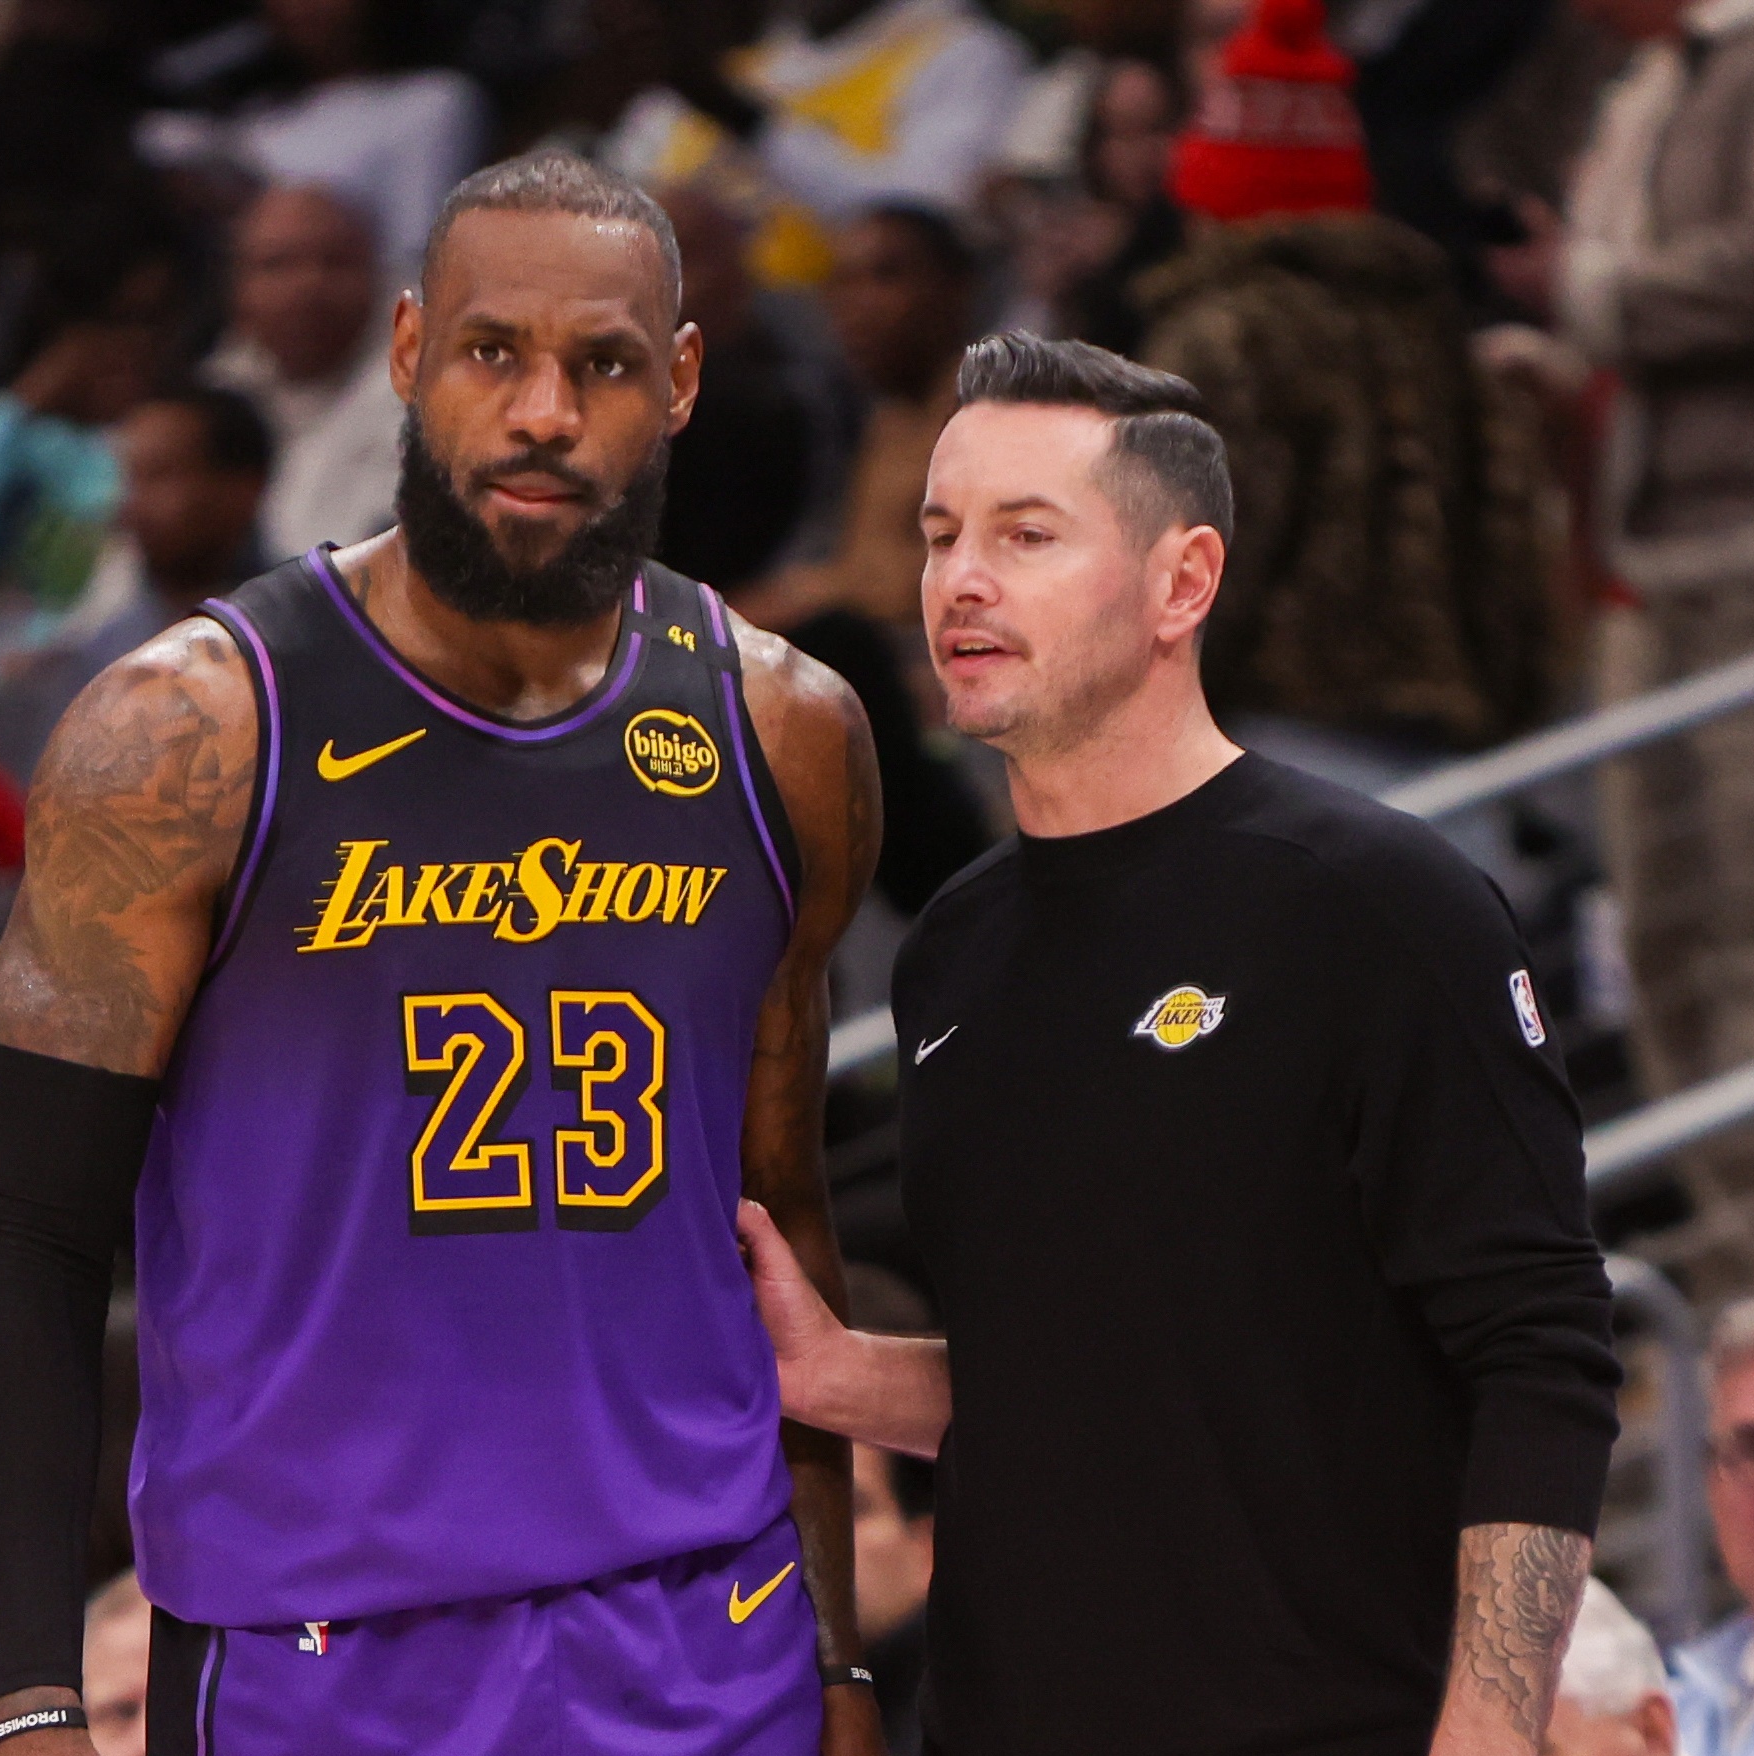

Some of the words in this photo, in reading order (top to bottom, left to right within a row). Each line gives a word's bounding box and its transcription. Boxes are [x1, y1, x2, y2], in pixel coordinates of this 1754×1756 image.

[667, 625, 695, 653] 44
[633, 729, 713, 775] bibigo
[649, 758, 684, 777] 비비고
[1141, 1001, 1220, 1030] LAKERS
[401, 989, 668, 1216] 23
